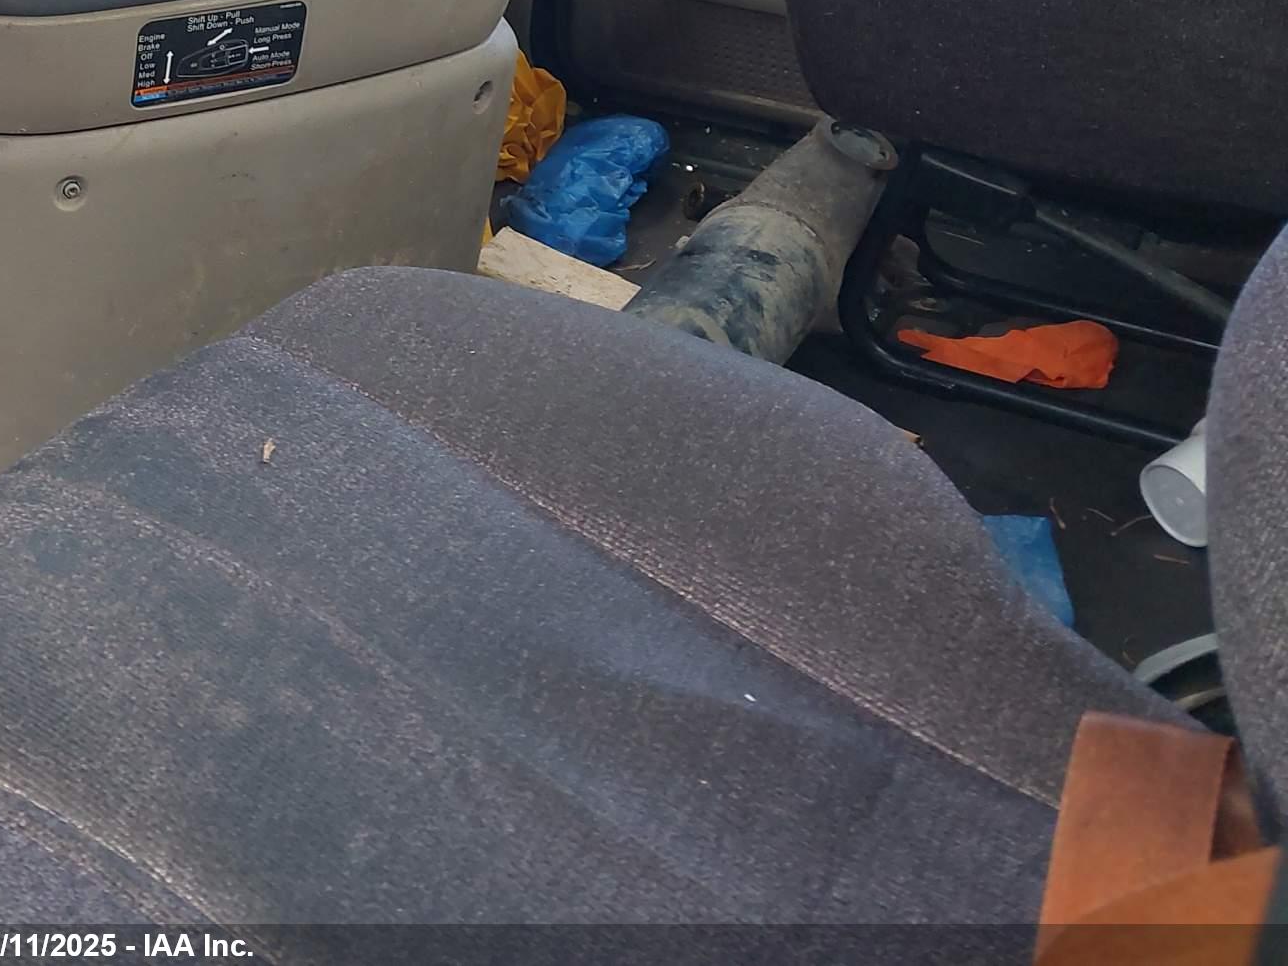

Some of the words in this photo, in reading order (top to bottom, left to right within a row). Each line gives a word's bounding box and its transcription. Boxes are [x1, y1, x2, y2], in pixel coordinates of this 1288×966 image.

[187, 15, 206, 24] Shift
[207, 14, 219, 22] Up
[225, 10, 241, 19] Pull
[187, 23, 204, 32] Shift
[206, 21, 228, 30] Down
[235, 16, 254, 25] Push
[254, 24, 280, 33] Manual
[281, 22, 301, 30] Mode
[138, 34, 165, 43] Engine
[253, 35, 271, 44] Long
[272, 33, 292, 41] Press
[138, 42, 160, 51] Brake
[140, 53, 153, 61] Off
[252, 53, 269, 61] Auto
[270, 51, 290, 59] Mode
[139, 62, 155, 70] Low
[250, 61, 271, 70] Short
[271, 59, 292, 67] Press
[138, 70, 155, 79] Med
[137, 79, 155, 88] High
